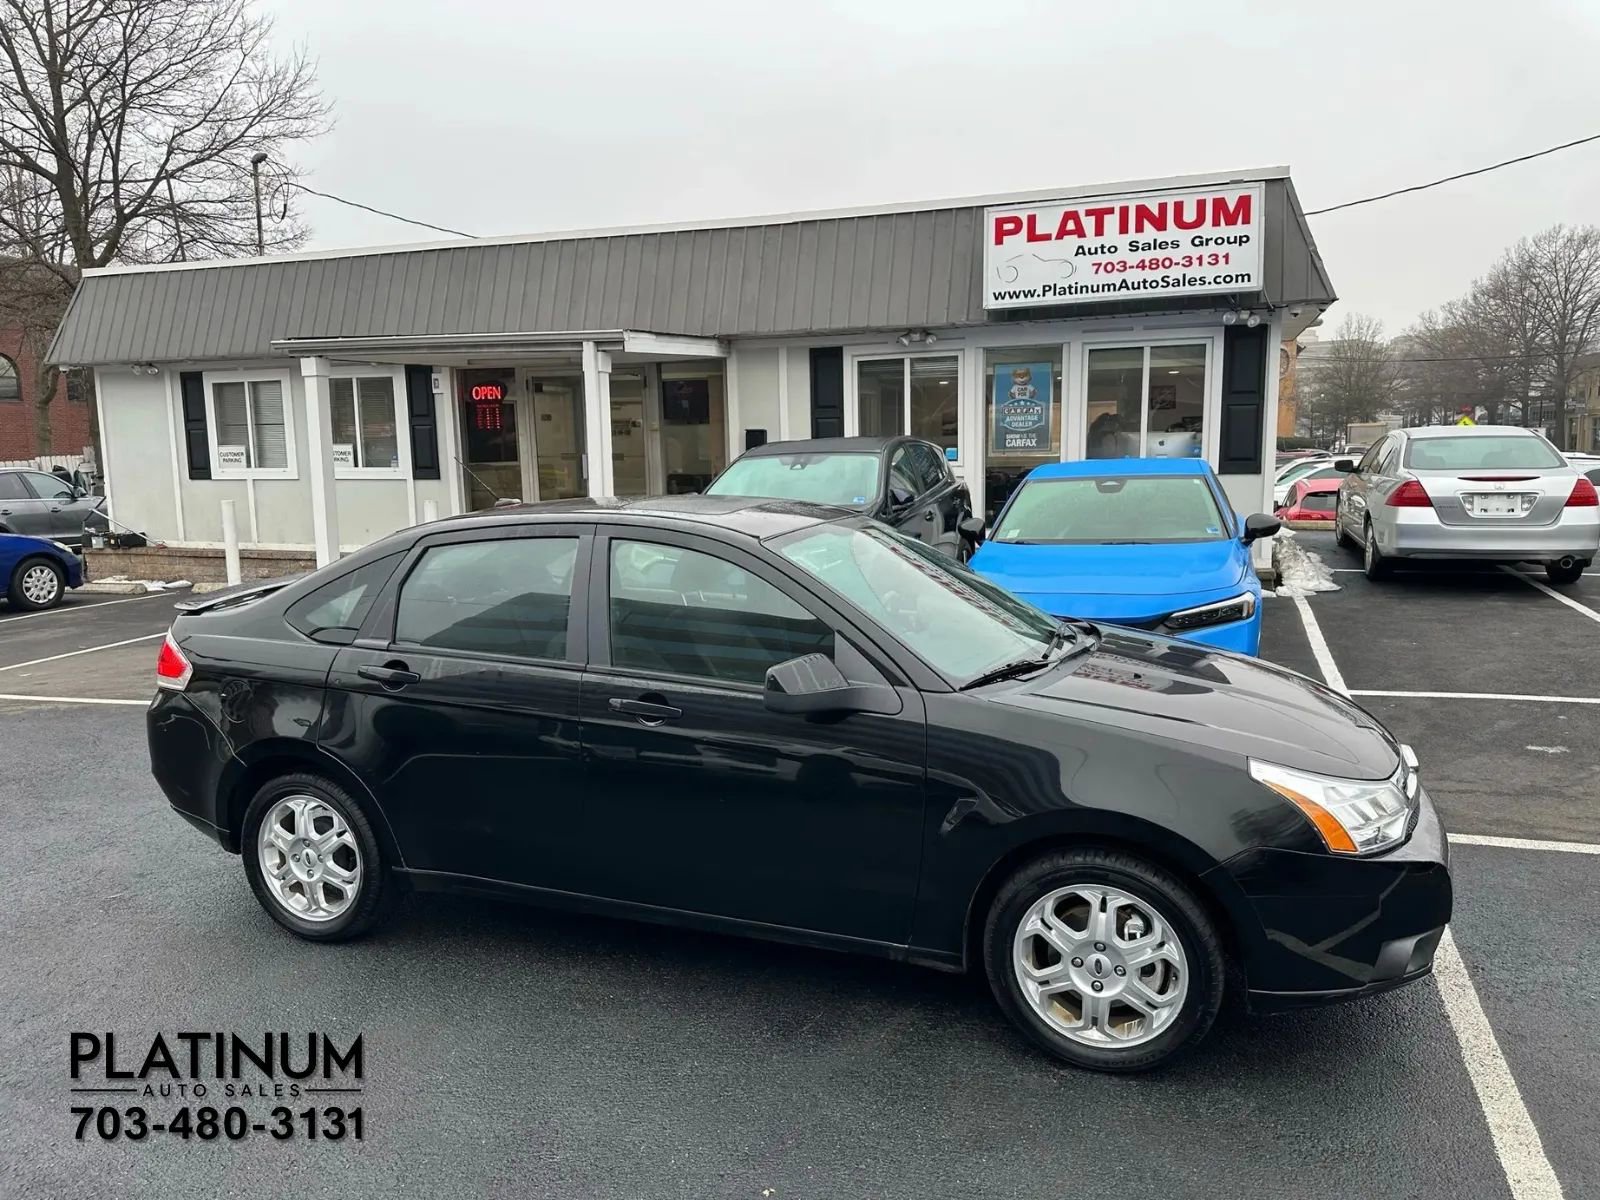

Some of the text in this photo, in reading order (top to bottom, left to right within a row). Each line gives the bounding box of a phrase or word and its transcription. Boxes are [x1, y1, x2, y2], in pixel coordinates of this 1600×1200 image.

[994, 194, 1252, 245] PLATINUM
[1074, 233, 1250, 257] Auto Sales Group
[1091, 252, 1231, 275] 703-480-3131
[992, 271, 1251, 301] www.PlatinumAutoSales.com
[472, 386, 501, 400] OPEN
[1005, 439, 1037, 447] CARFAX
